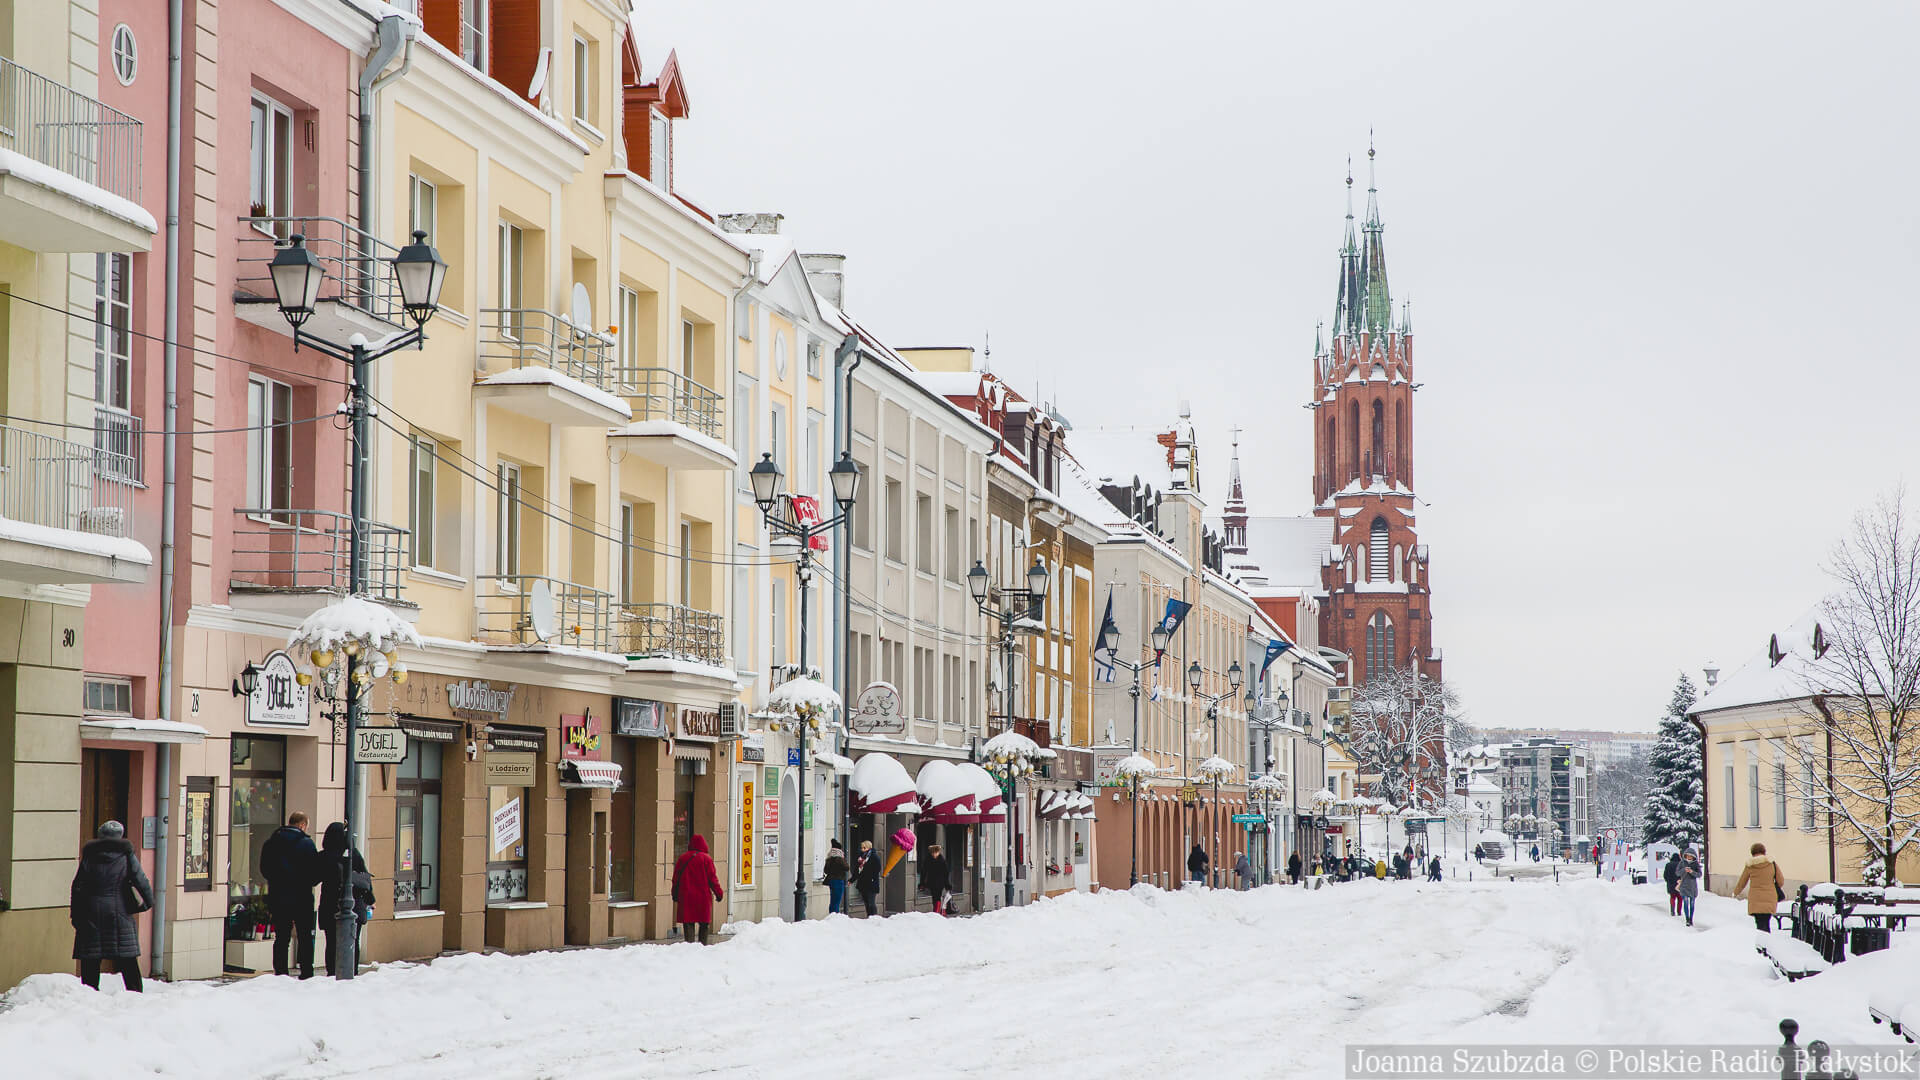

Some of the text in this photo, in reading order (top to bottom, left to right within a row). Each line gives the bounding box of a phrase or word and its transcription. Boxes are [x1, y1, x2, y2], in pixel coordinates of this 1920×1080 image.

[63, 628, 75, 647] 30
[192, 692, 199, 713] 28
[359, 732, 398, 751] TYGIEL
[359, 751, 397, 759] Restauracja
[744, 785, 752, 881] FOTOGRAF
